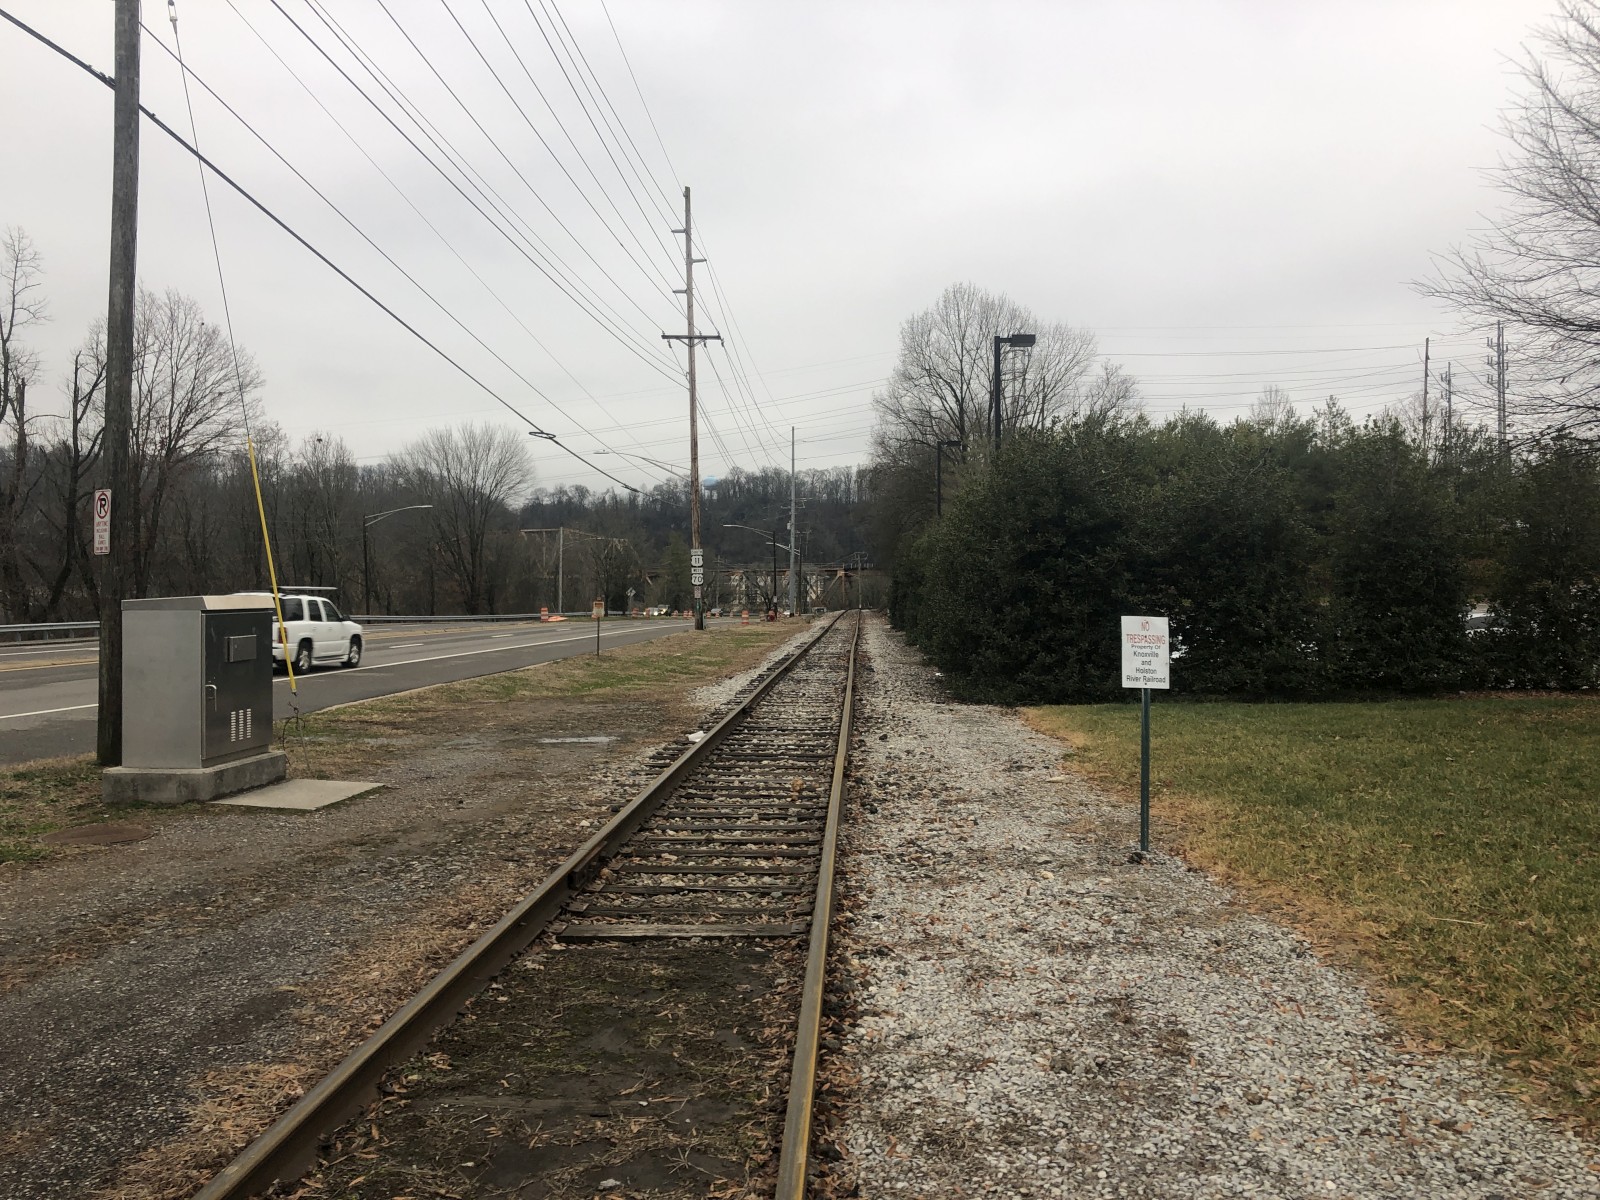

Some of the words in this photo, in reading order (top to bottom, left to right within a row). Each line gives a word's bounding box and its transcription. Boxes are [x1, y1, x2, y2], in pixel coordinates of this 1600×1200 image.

[694, 557, 700, 565] 11
[693, 575, 703, 583] 70
[1141, 620, 1150, 632] NO
[1126, 633, 1166, 645] TRESPASSING
